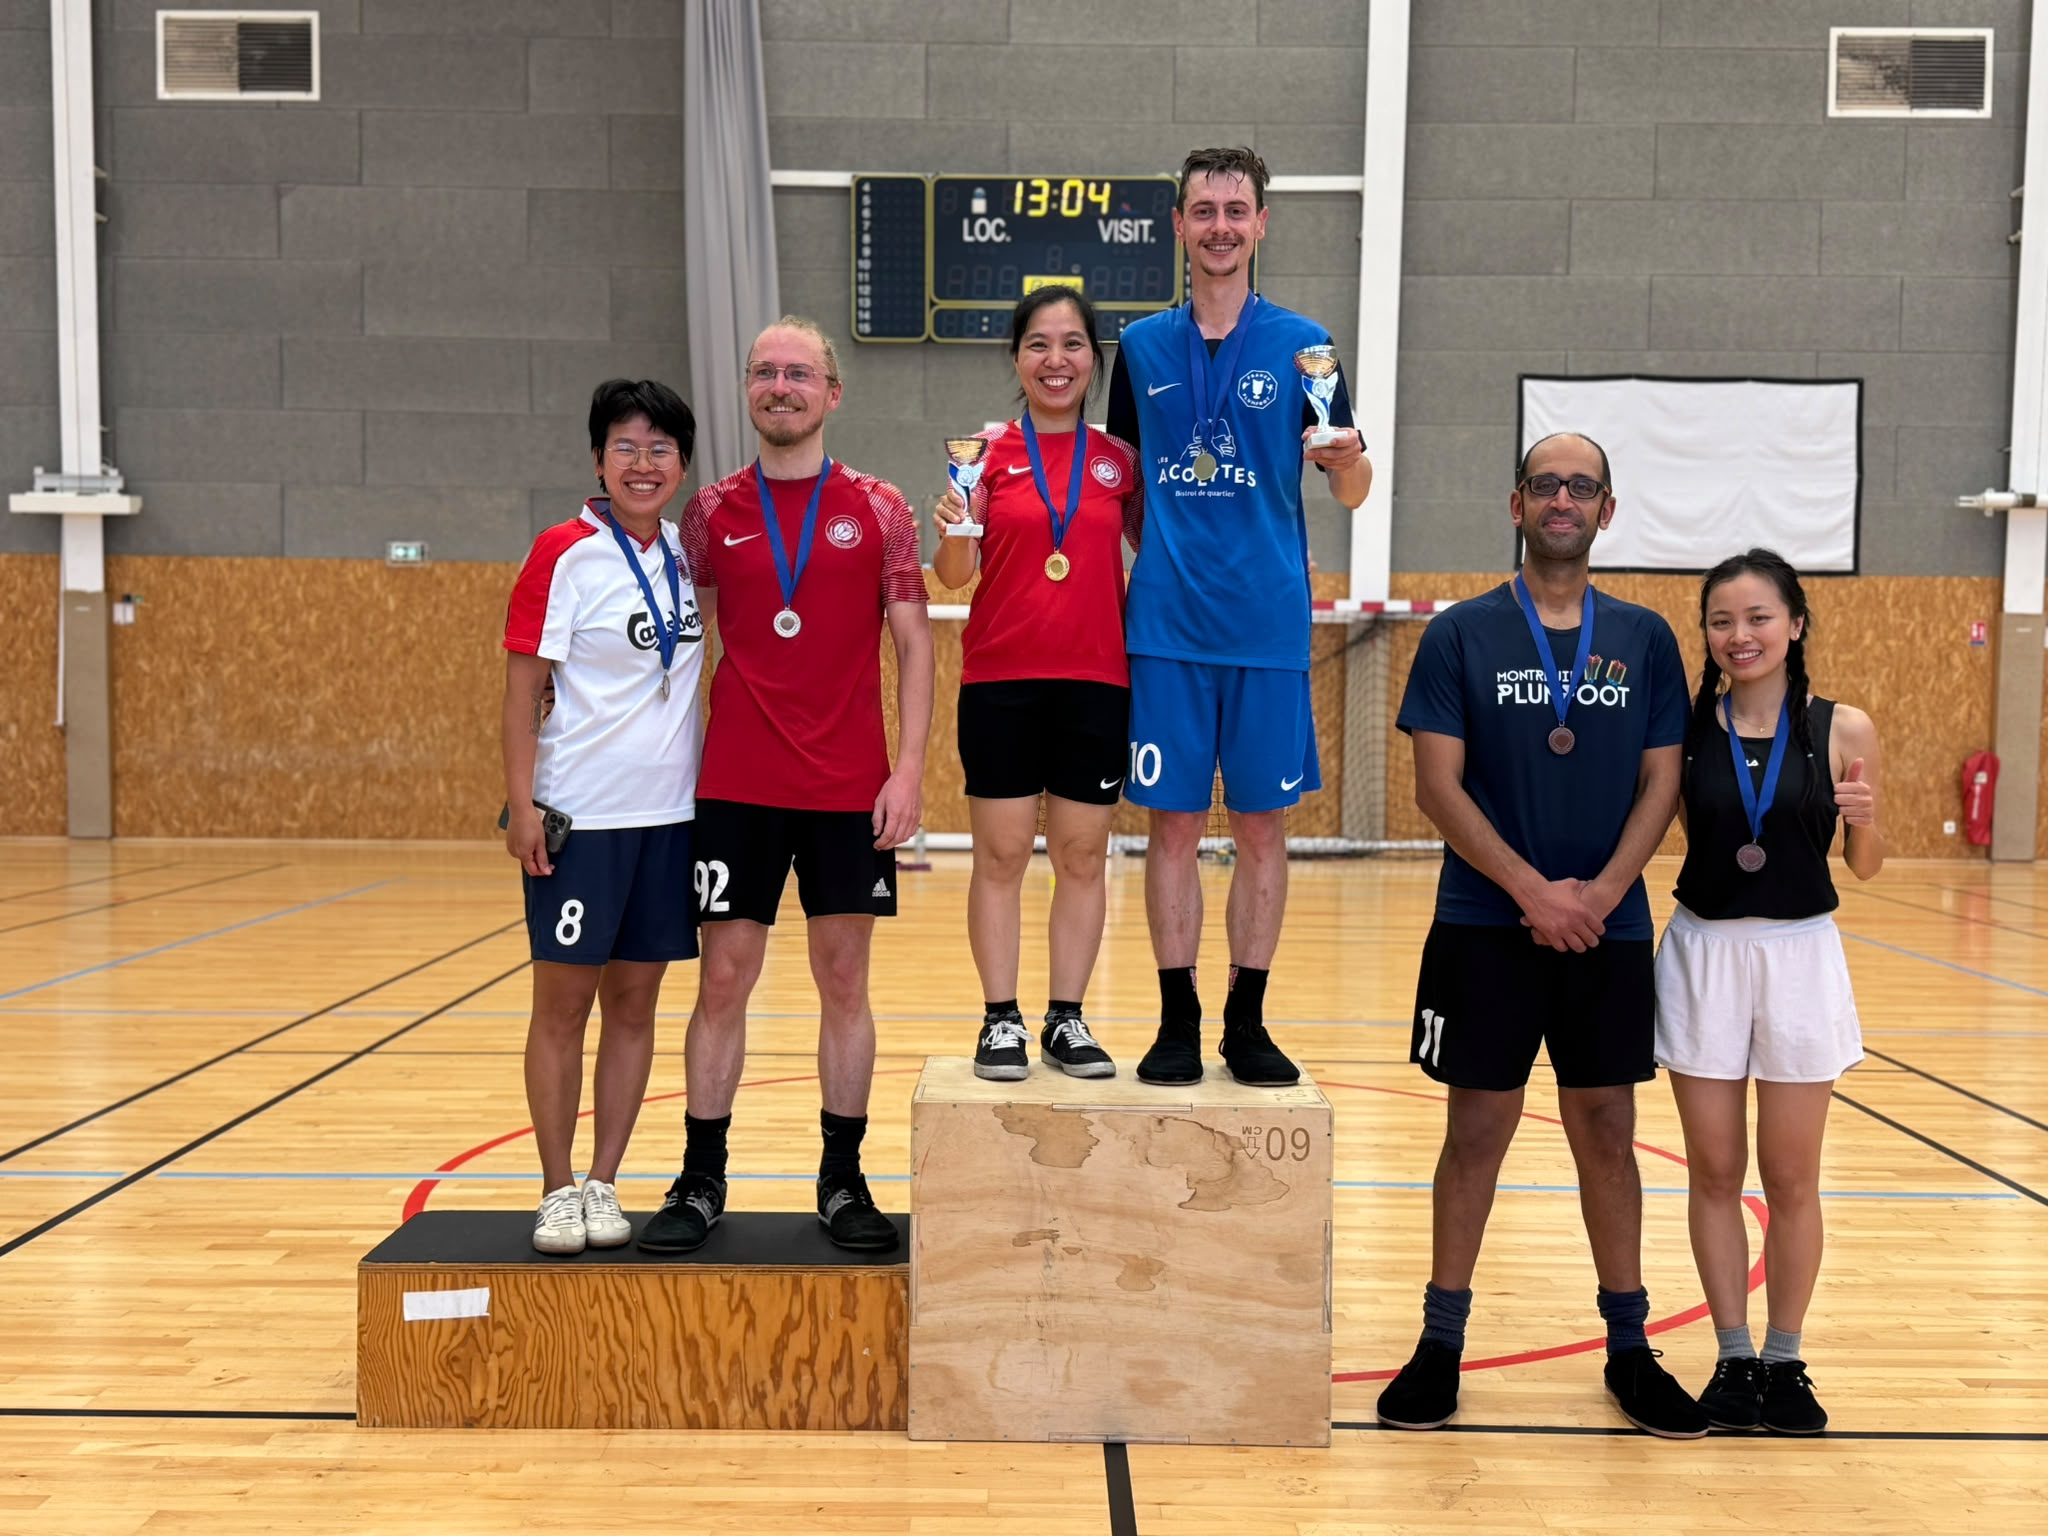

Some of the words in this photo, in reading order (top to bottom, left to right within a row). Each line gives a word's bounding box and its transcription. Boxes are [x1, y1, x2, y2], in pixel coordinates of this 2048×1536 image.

[1014, 179, 1111, 217] 13:04
[962, 217, 1012, 243] LOC.
[1097, 218, 1156, 244] VISIT.
[1497, 669, 1574, 683] MONTRI
[1130, 741, 1162, 787] 10
[694, 860, 730, 912] 92
[555, 899, 584, 946] 8
[1419, 1008, 1445, 1068] 11
